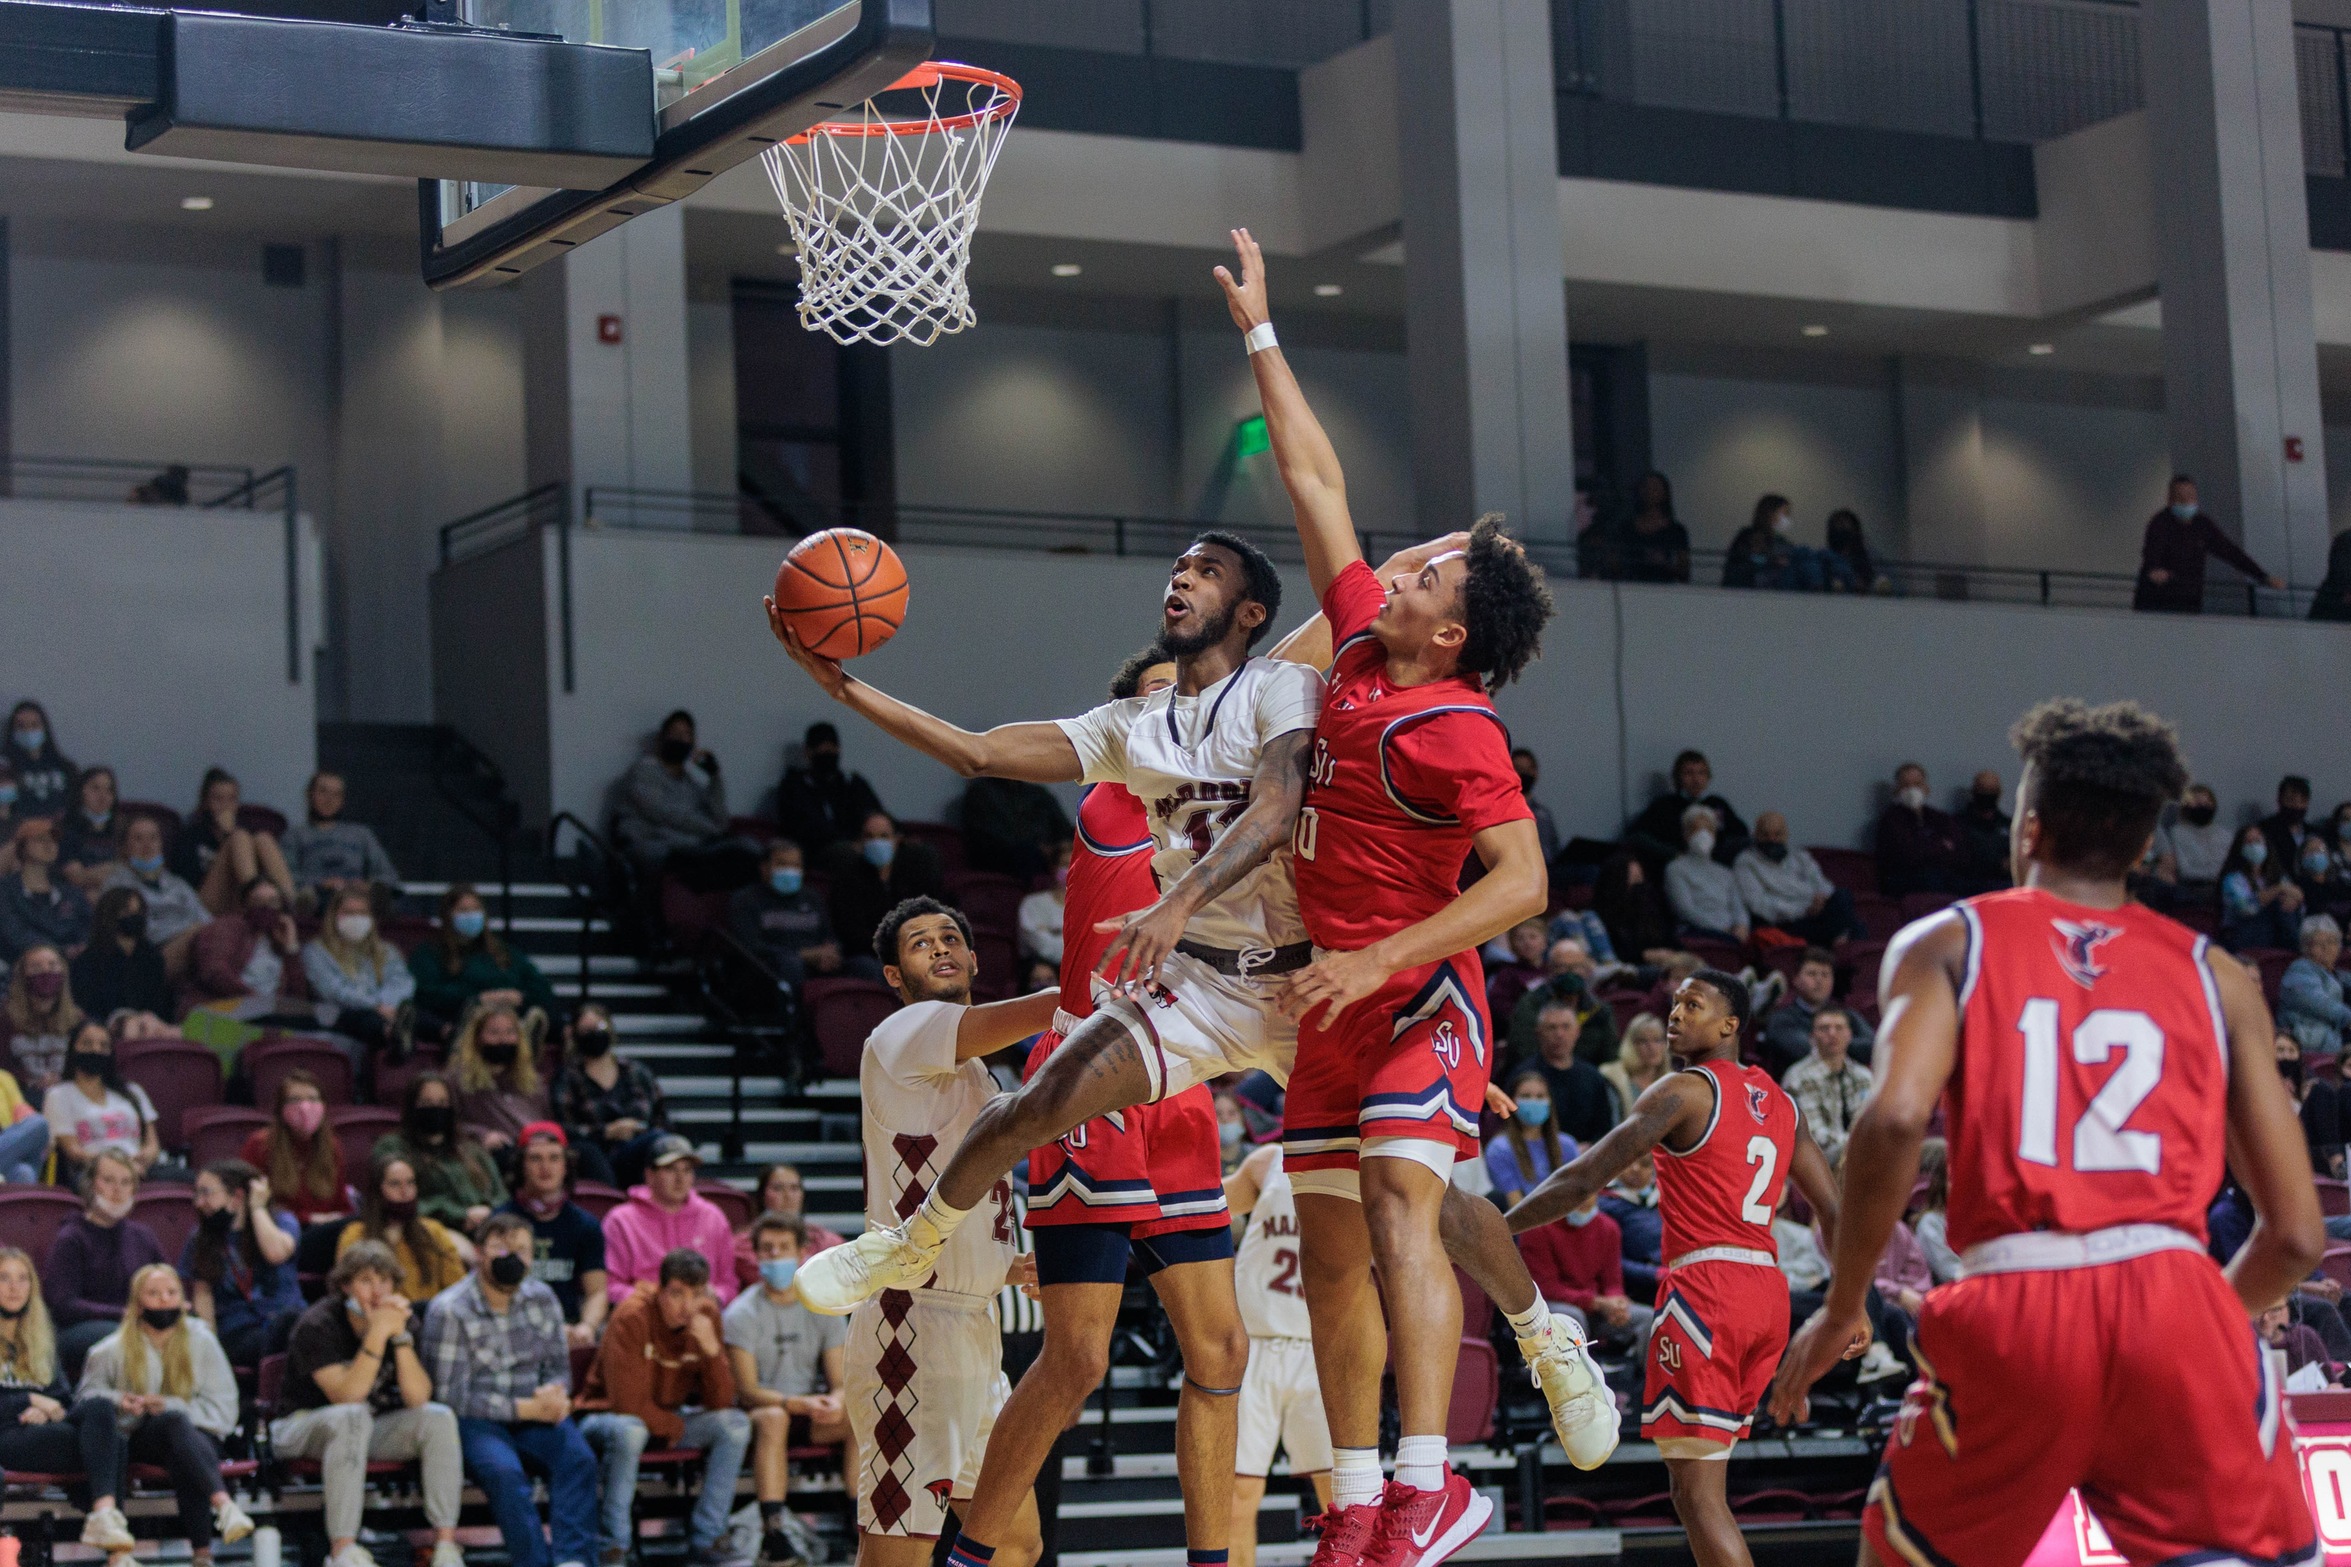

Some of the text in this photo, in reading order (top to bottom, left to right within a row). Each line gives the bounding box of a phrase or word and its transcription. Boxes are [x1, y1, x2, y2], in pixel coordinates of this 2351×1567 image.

[1433, 1019, 1461, 1069] SU
[2015, 996, 2167, 1177] 12
[1741, 1135, 1778, 1227] 2
[1267, 1247, 1307, 1300] 2
[1658, 1335, 1682, 1370] SU
